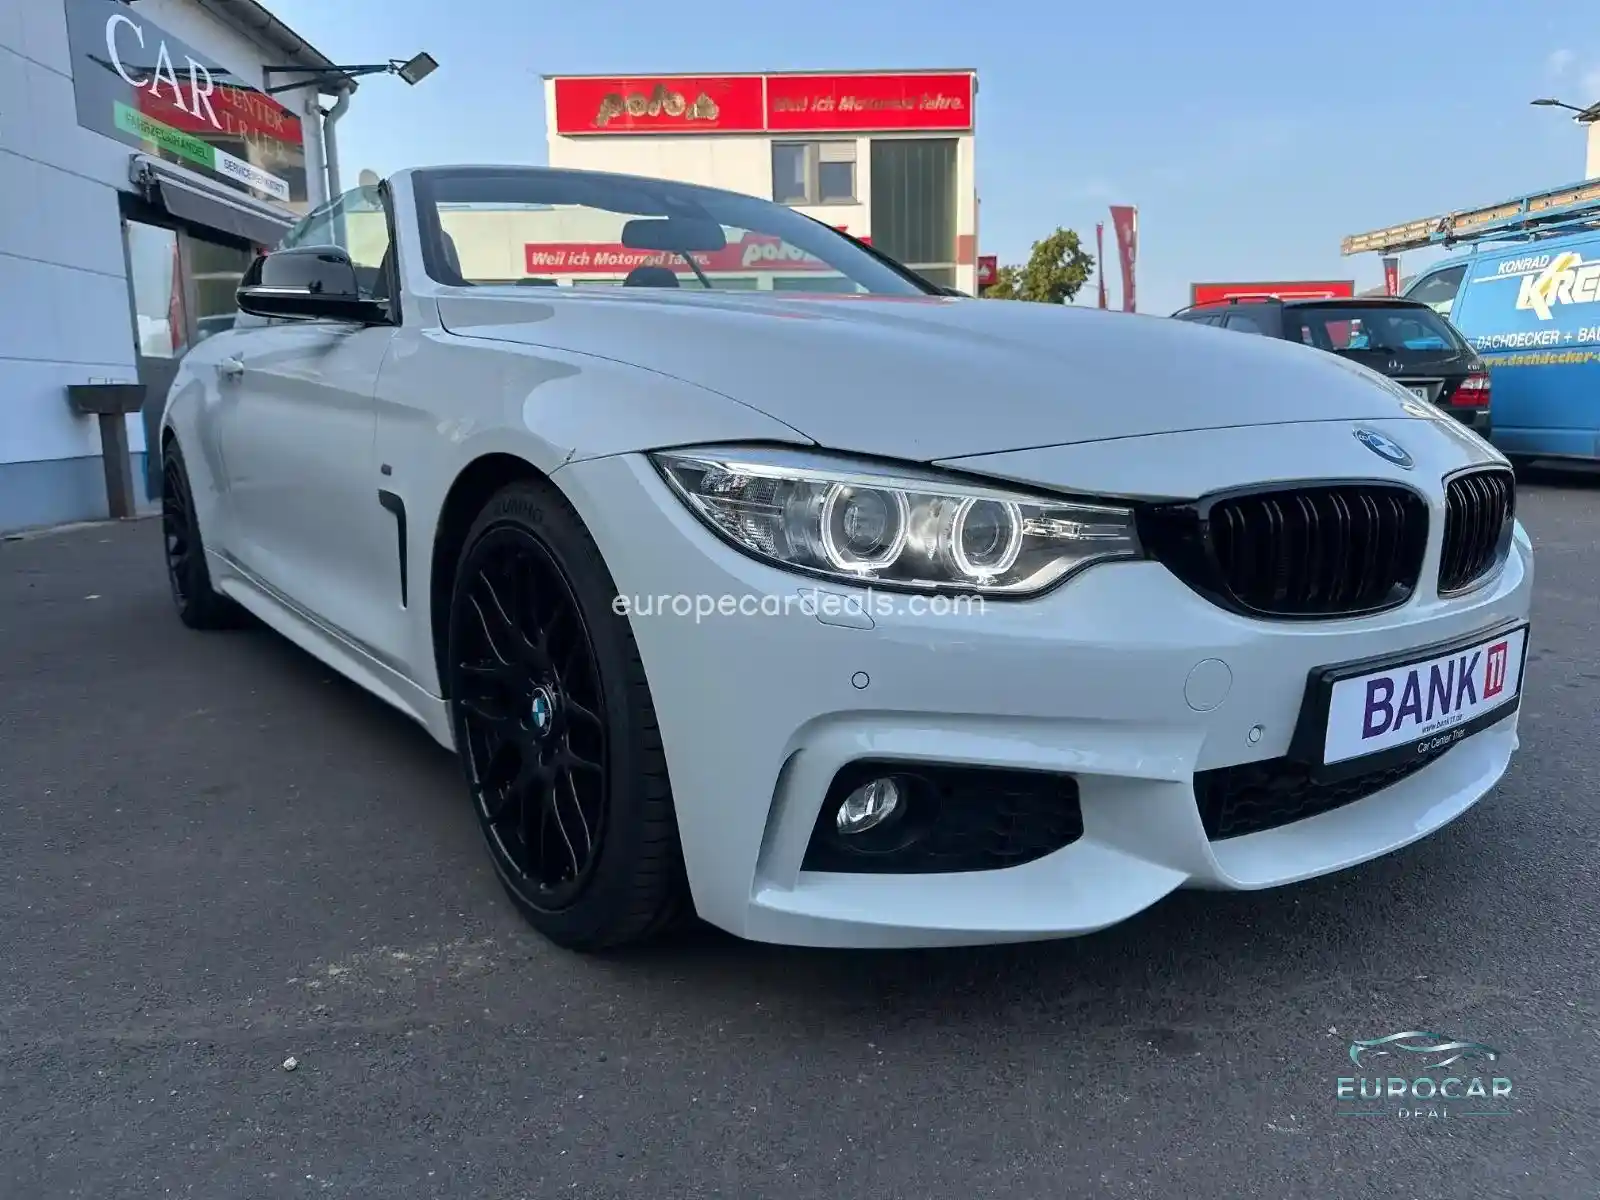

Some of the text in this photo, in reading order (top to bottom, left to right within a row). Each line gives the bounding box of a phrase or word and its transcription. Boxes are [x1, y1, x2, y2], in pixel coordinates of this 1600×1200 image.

[105, 14, 223, 130] CAR
[219, 83, 285, 133] CENTER
[532, 251, 564, 266] Weil
[568, 249, 590, 266] ich
[1497, 254, 1550, 275] KONRAD
[1515, 251, 1600, 320] KRE
[1476, 329, 1560, 350] DACHDECKER
[1361, 650, 1482, 740] BANK
[1417, 741, 1431, 754] Car
[1430, 734, 1452, 749] Center
